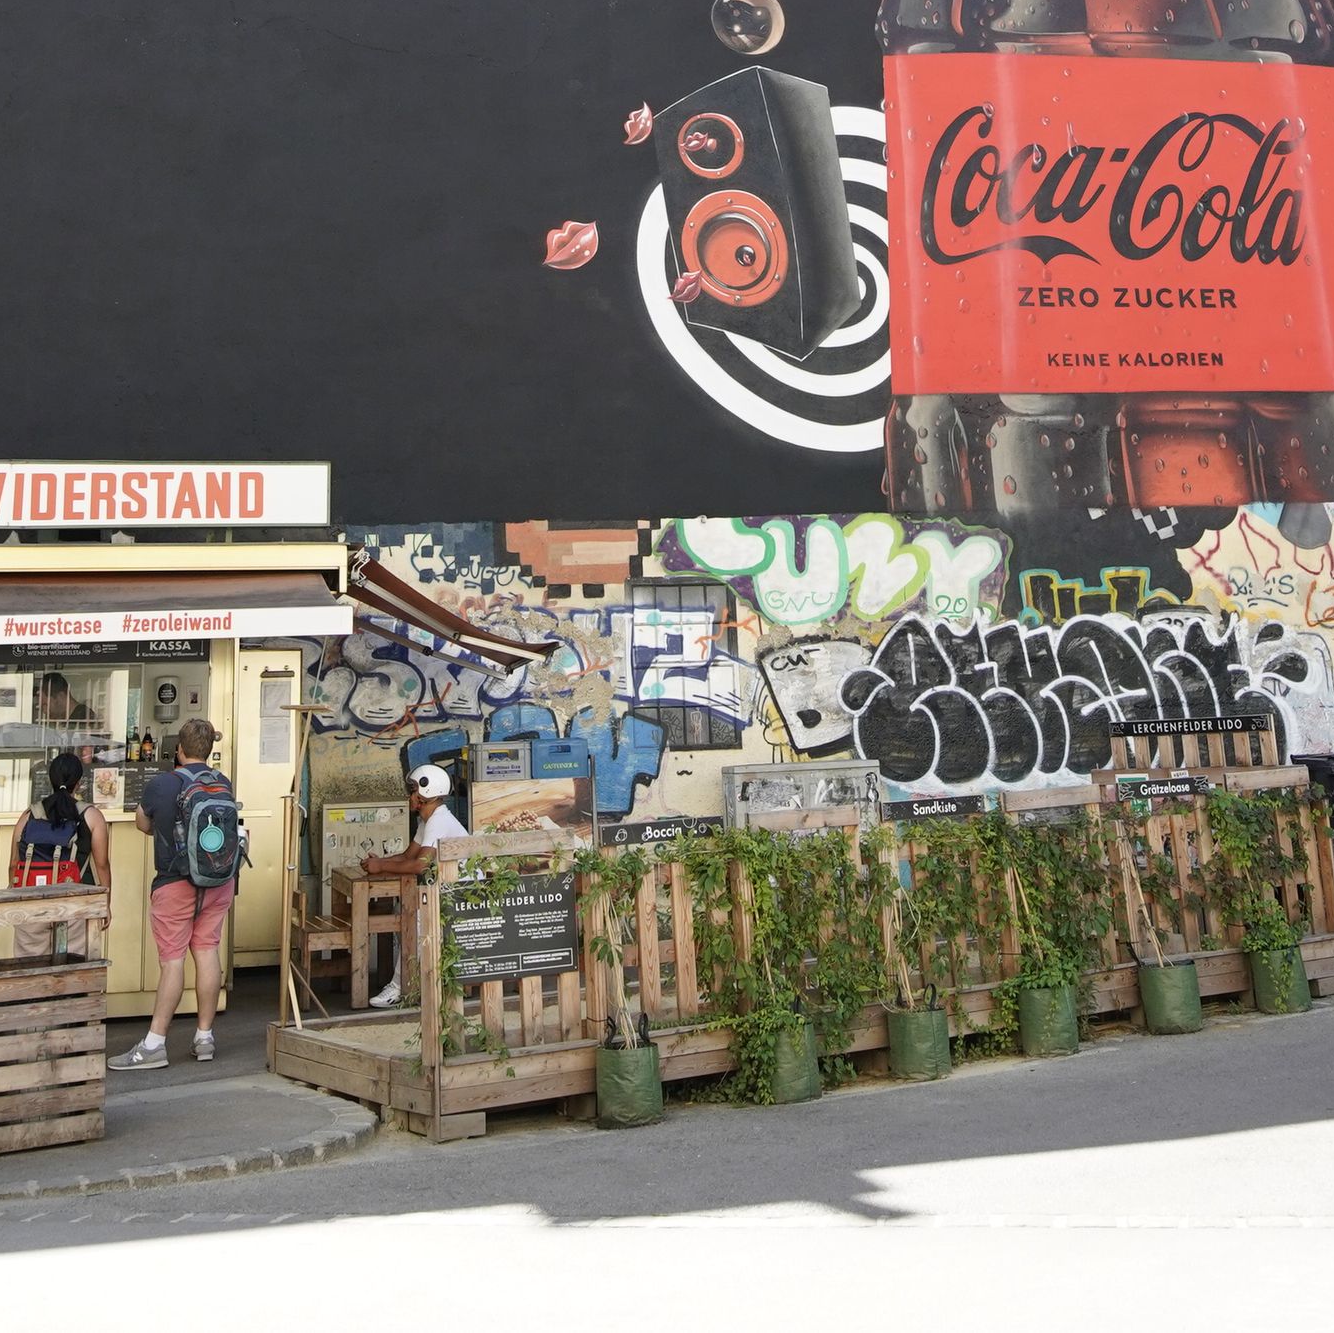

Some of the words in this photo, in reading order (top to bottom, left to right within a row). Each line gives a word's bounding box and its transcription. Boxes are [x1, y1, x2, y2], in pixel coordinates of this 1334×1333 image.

[920, 106, 1307, 266] Coca-Cola
[1018, 287, 1099, 308] ZERO
[1114, 287, 1237, 309] ZUCKER
[1047, 353, 1110, 367] KEINE
[1119, 352, 1224, 367] KALORIEN
[4, 617, 102, 637] #wurstcase
[122, 612, 233, 634] #zeroleiwand
[150, 641, 191, 651] KASSA
[1132, 720, 1214, 735] LERCHENFELDER
[1217, 718, 1244, 730] LIDO
[1139, 780, 1191, 797] Grätzeloase
[912, 801, 958, 816] Sandkiste
[540, 892, 564, 904] LIDO
